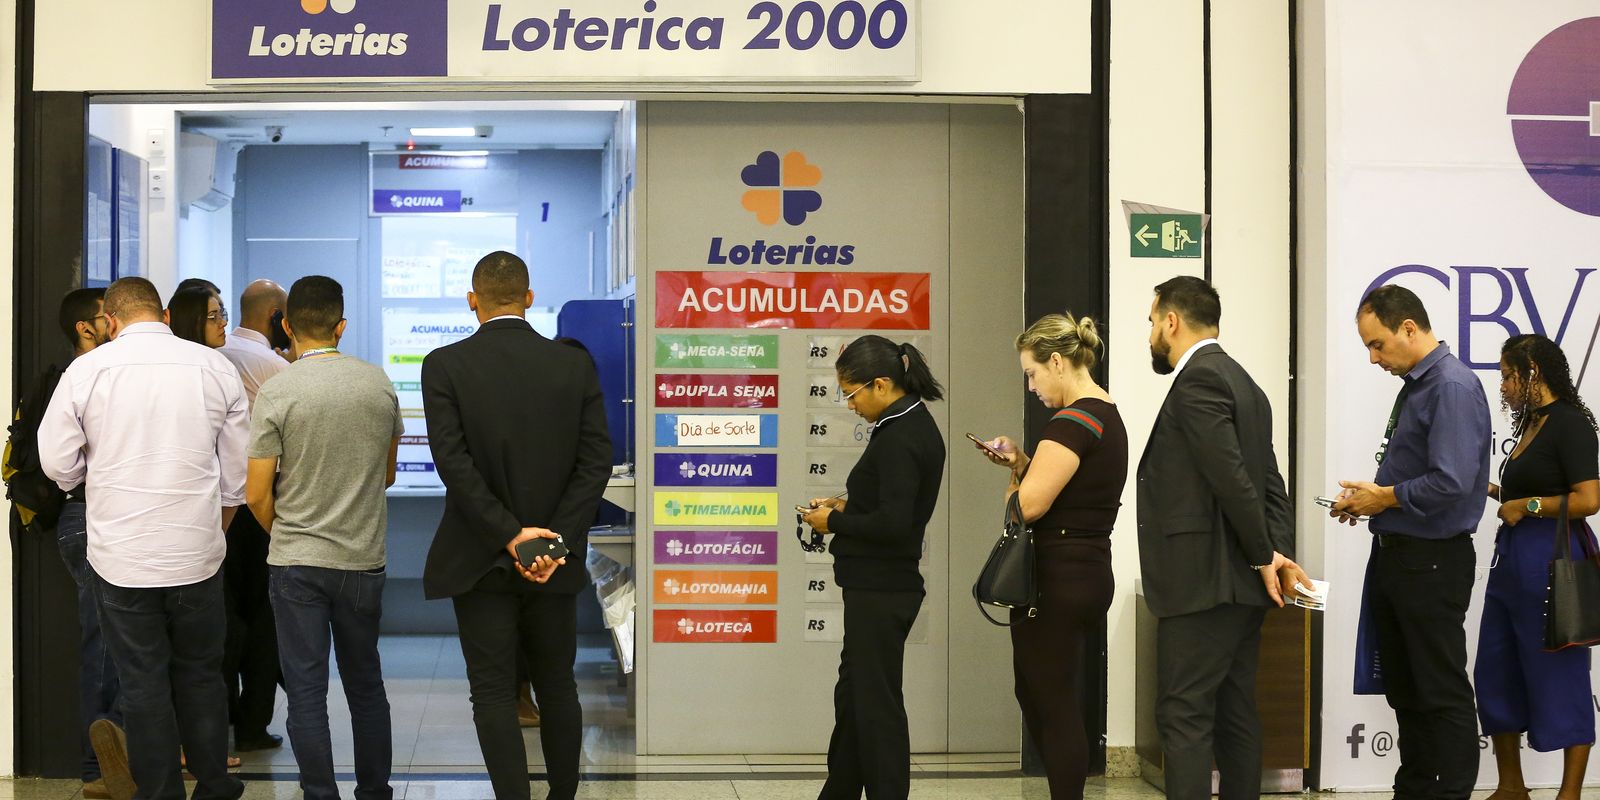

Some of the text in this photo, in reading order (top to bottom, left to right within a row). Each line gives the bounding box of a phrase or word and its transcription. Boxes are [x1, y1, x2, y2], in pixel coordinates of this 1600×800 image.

[482, 0, 908, 52] Loterica 2000
[248, 23, 408, 56] Loterias
[403, 196, 444, 208] QUINA
[541, 202, 549, 222] 1
[708, 235, 855, 265] Loterias
[677, 287, 910, 314] ACUMULADAS
[410, 325, 474, 334] ACUMULADO
[687, 345, 765, 357] MEGA-SENA
[810, 346, 828, 358] R$
[674, 385, 776, 398] DUPLA SENA
[809, 385, 828, 397] R$
[705, 421, 721, 435] de
[724, 421, 756, 436] Sorte
[809, 424, 828, 436] R$
[697, 464, 753, 478] QUINA
[809, 463, 827, 475] R$
[683, 504, 767, 515] TIMEMANIA
[684, 541, 765, 555] LOTOFÁCIL
[681, 583, 768, 594] LOTOMANIA
[808, 580, 826, 592] R$
[695, 622, 753, 633] LOTECA
[807, 619, 825, 631] R$
